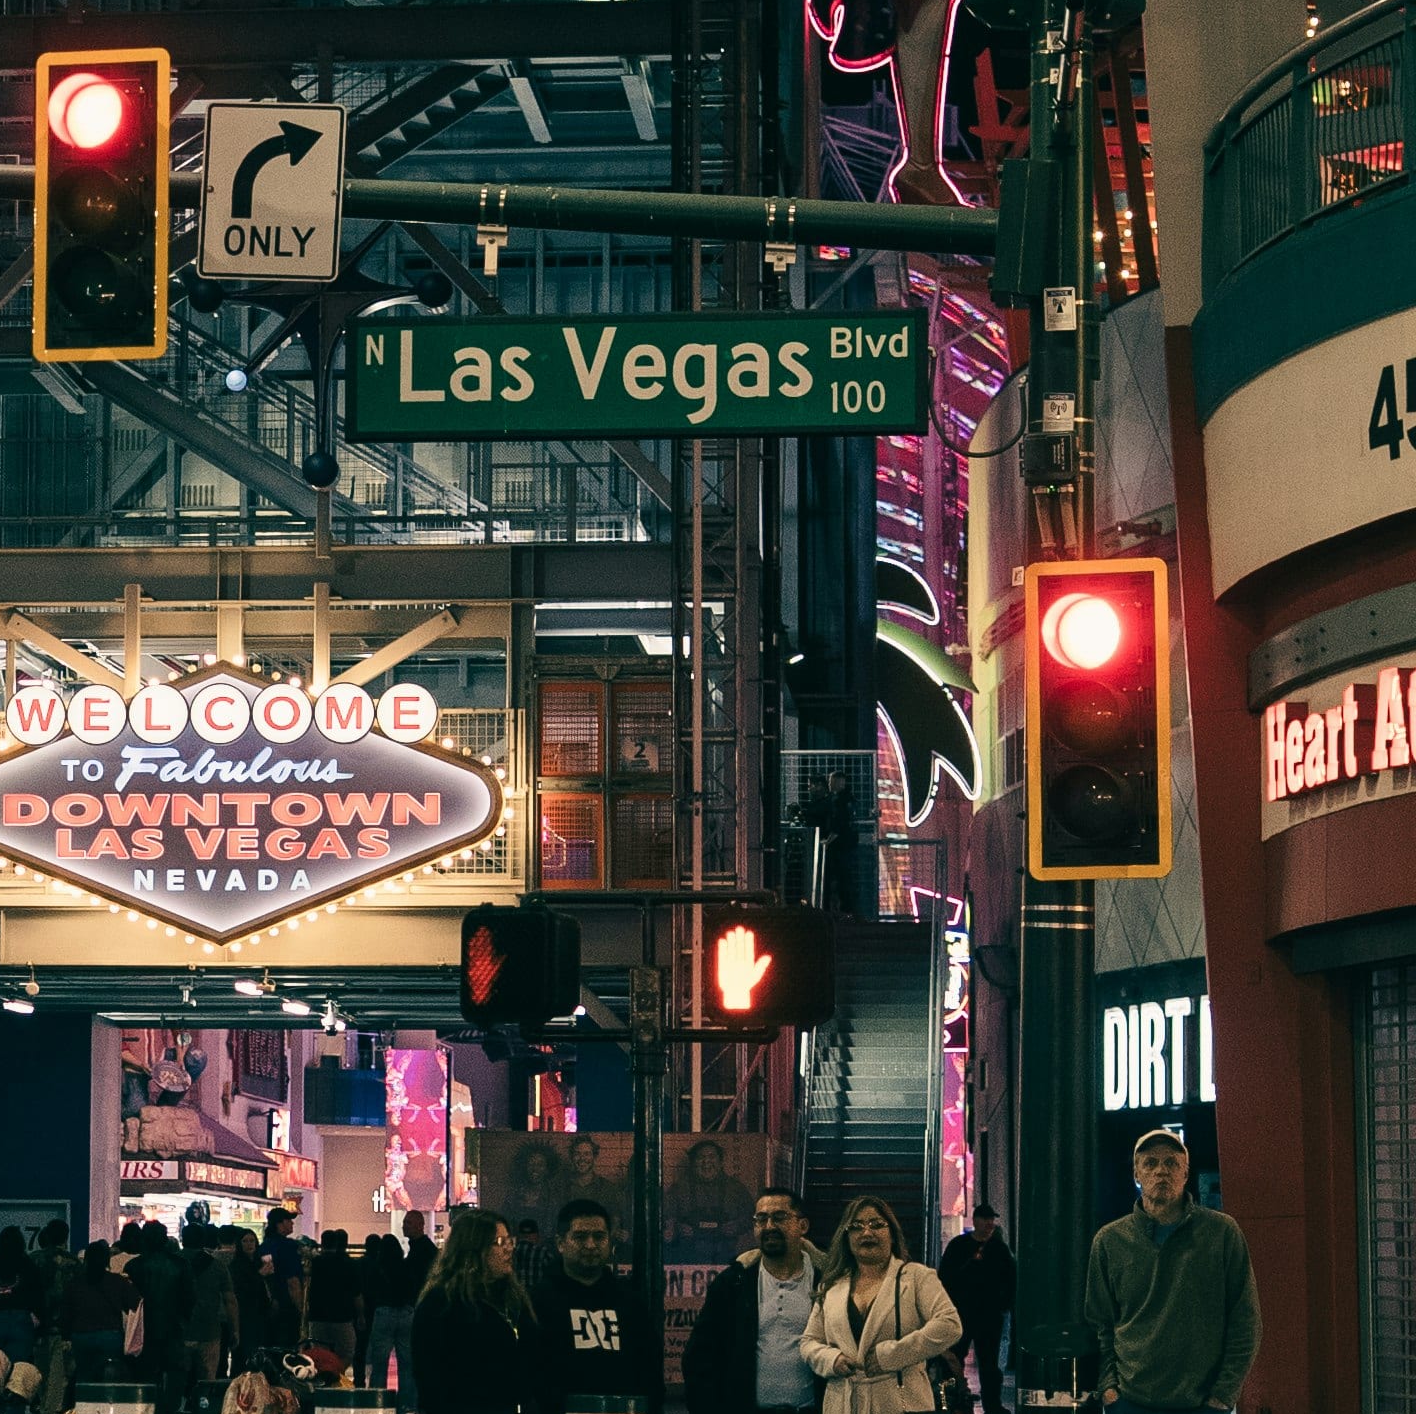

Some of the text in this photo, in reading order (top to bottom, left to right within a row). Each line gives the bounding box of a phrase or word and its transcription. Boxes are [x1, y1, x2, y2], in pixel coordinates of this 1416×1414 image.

[224, 224, 315, 258] ONLY
[365, 327, 908, 425] N Las Vegas Blvd
[830, 380, 886, 414] 100
[15, 695, 421, 732] WELCOME
[634, 743, 646, 758] 2
[1266, 683, 1358, 802] Heart
[61, 745, 354, 792] TO Fabulous
[2, 792, 441, 827] DOWNTOWN
[55, 828, 391, 859] LAS VEGAS
[133, 868, 311, 891] NEVADA
[1103, 997, 1192, 1111] DIRT
[569, 1308, 622, 1351] DC
